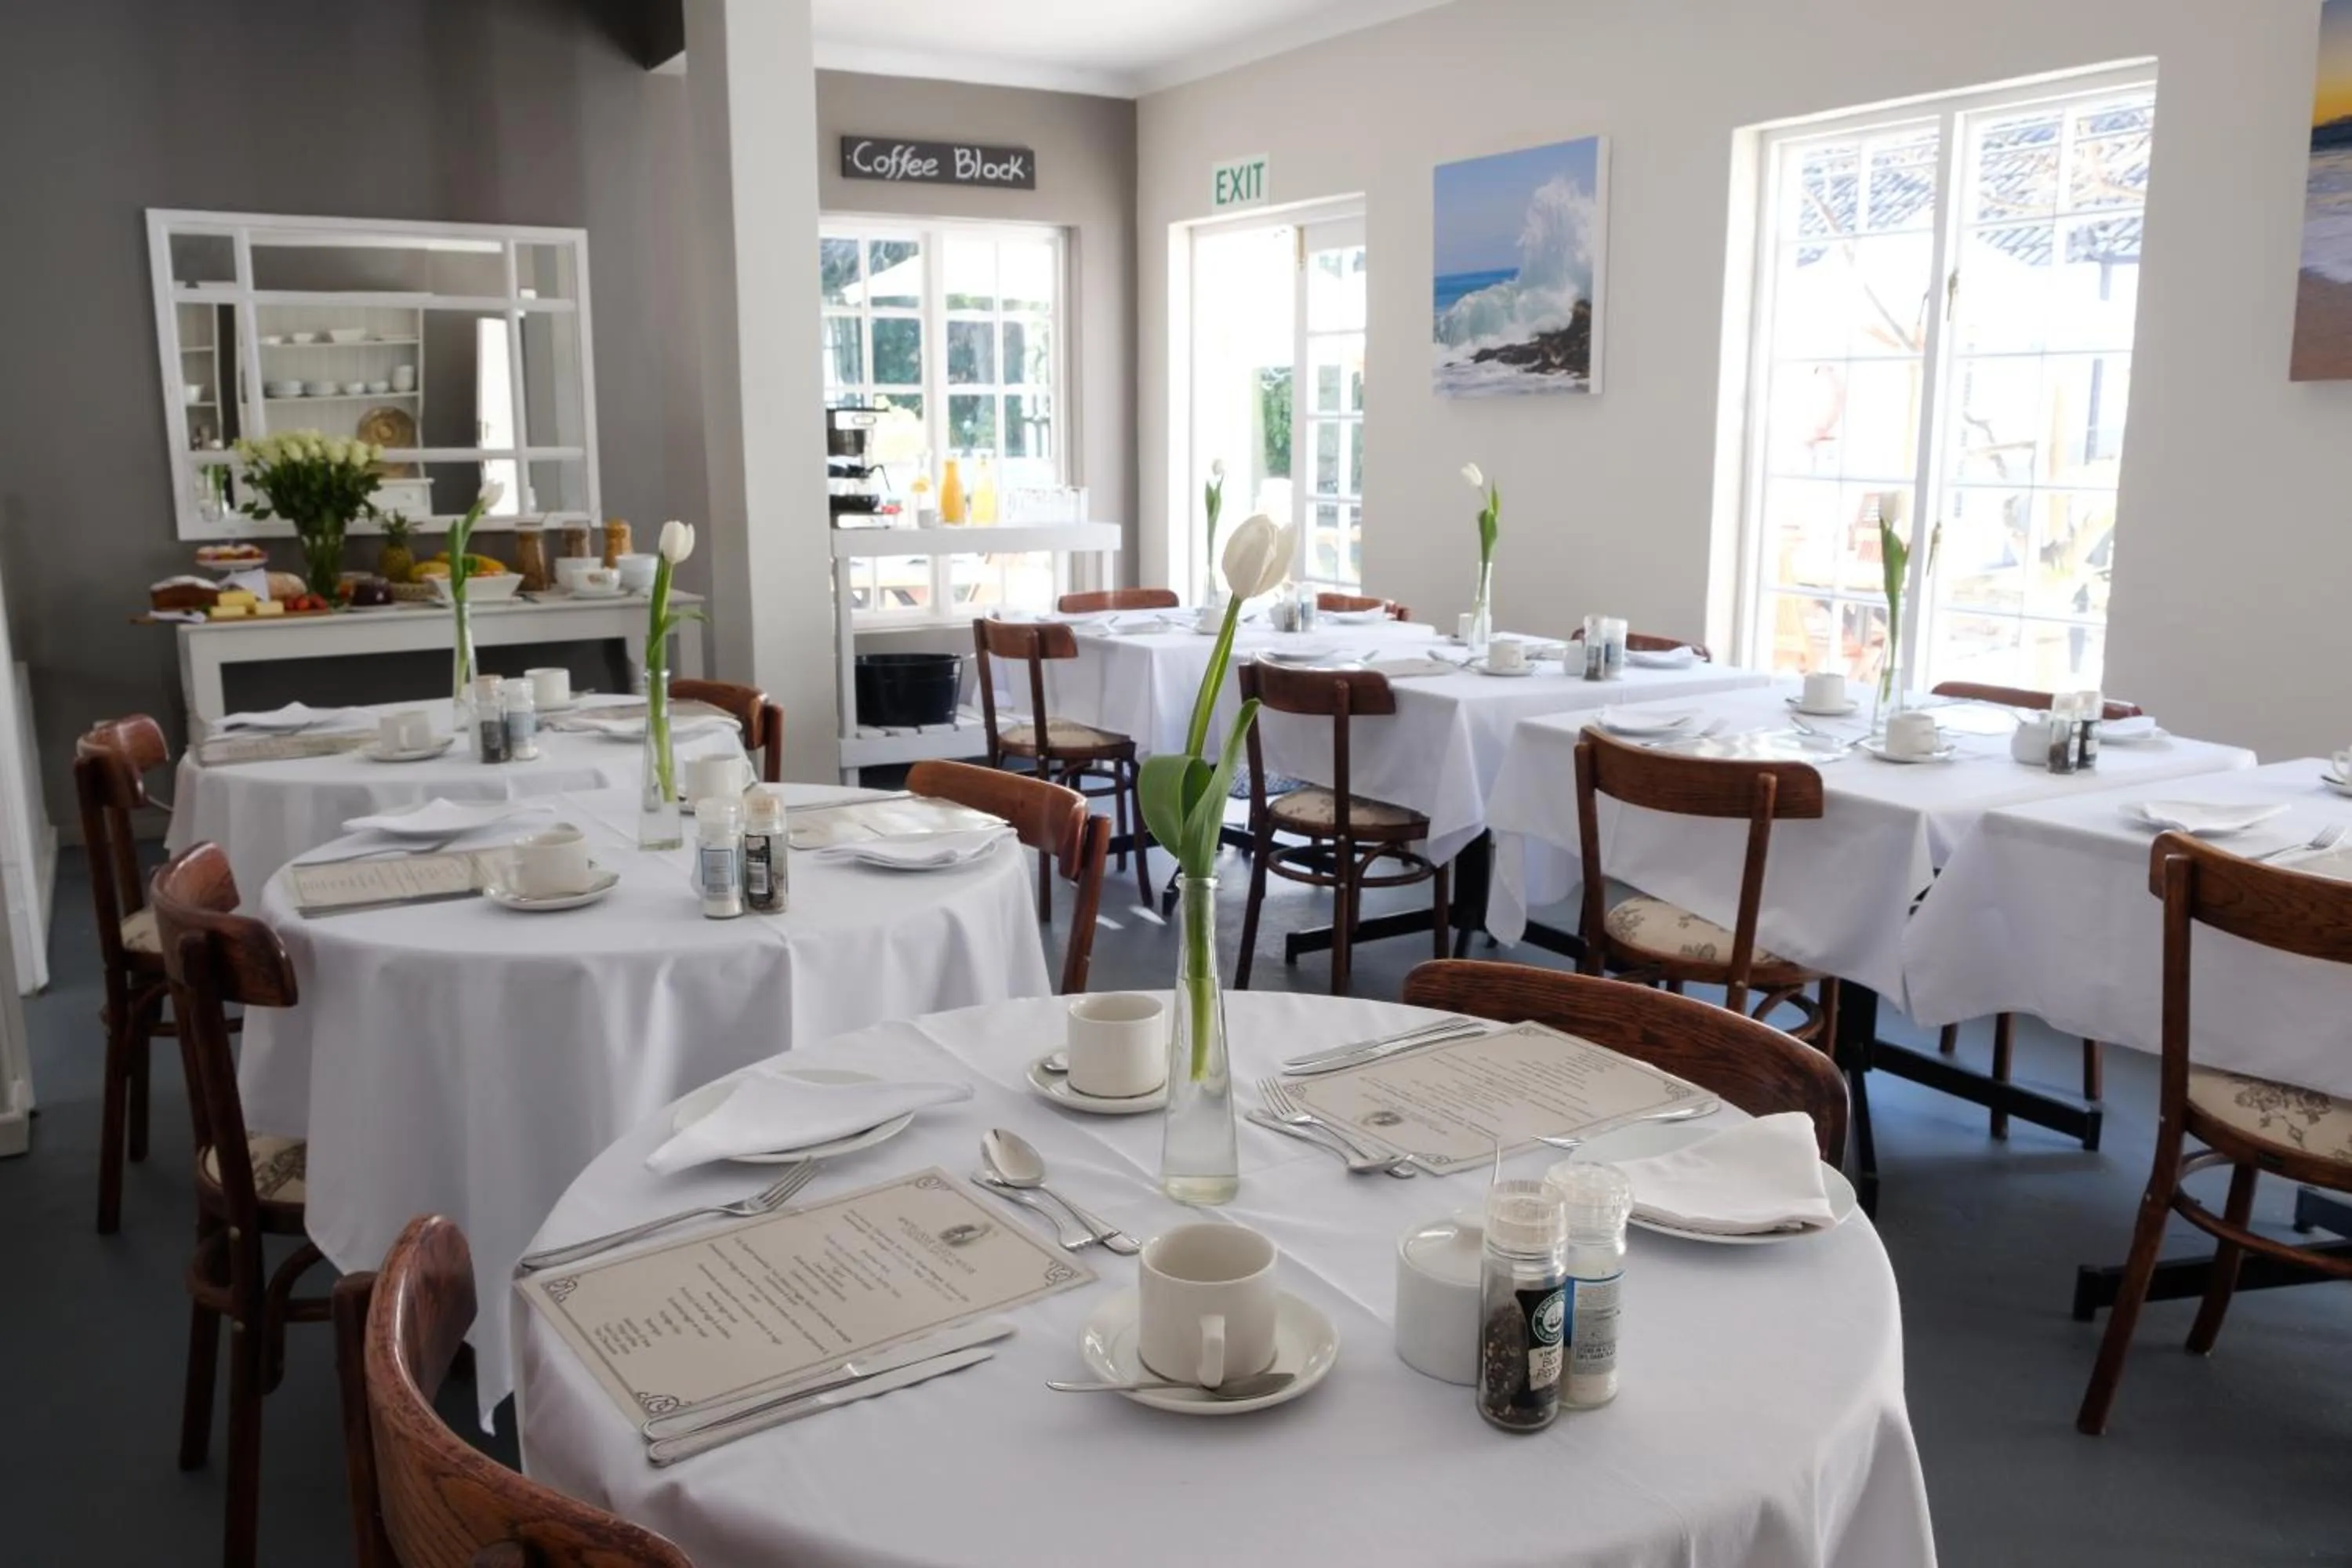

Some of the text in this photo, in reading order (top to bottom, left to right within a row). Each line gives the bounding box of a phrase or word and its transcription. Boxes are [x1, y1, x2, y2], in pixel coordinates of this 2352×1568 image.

[852, 140, 1025, 182] Coffee Block
[1216, 161, 1265, 205] EXIT
